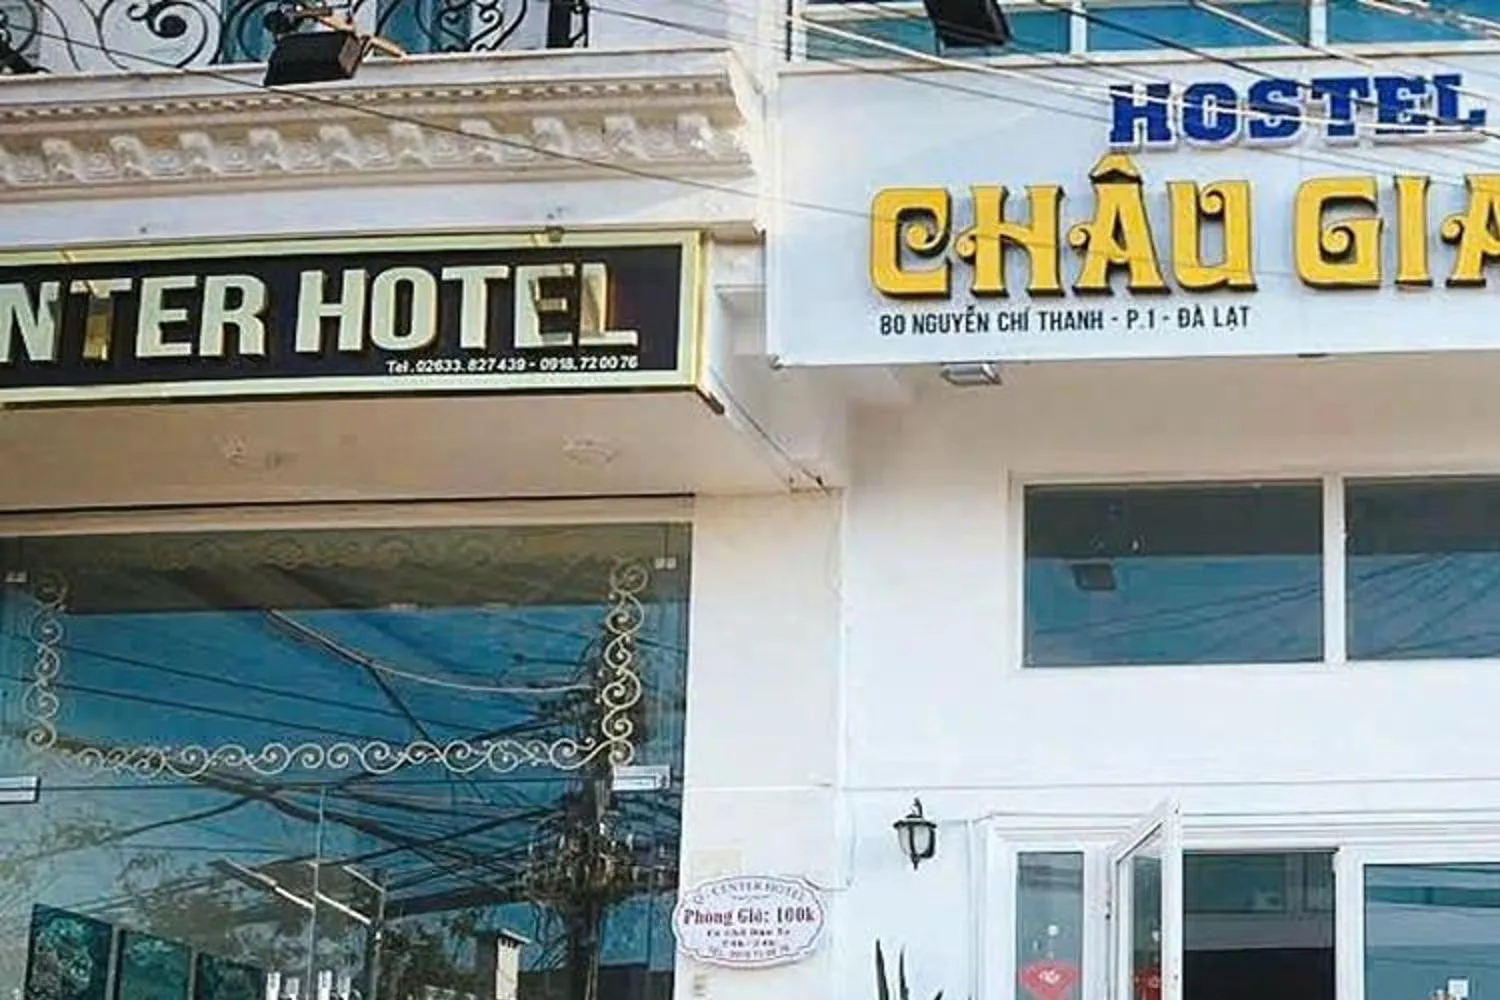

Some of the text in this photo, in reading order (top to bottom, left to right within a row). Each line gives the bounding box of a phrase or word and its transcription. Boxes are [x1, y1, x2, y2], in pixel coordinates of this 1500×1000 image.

[1109, 73, 1486, 147] HOSTEL
[870, 153, 1257, 298] CHÂU
[0, 262, 639, 363] NTER HOTEL
[880, 314, 906, 335] 80
[912, 305, 990, 335] NGUYỄN
[997, 308, 1031, 333] CHÍ
[1037, 310, 1104, 332] THANH
[1177, 303, 1207, 330] ĐÀ
[1213, 305, 1252, 333] LẠT
